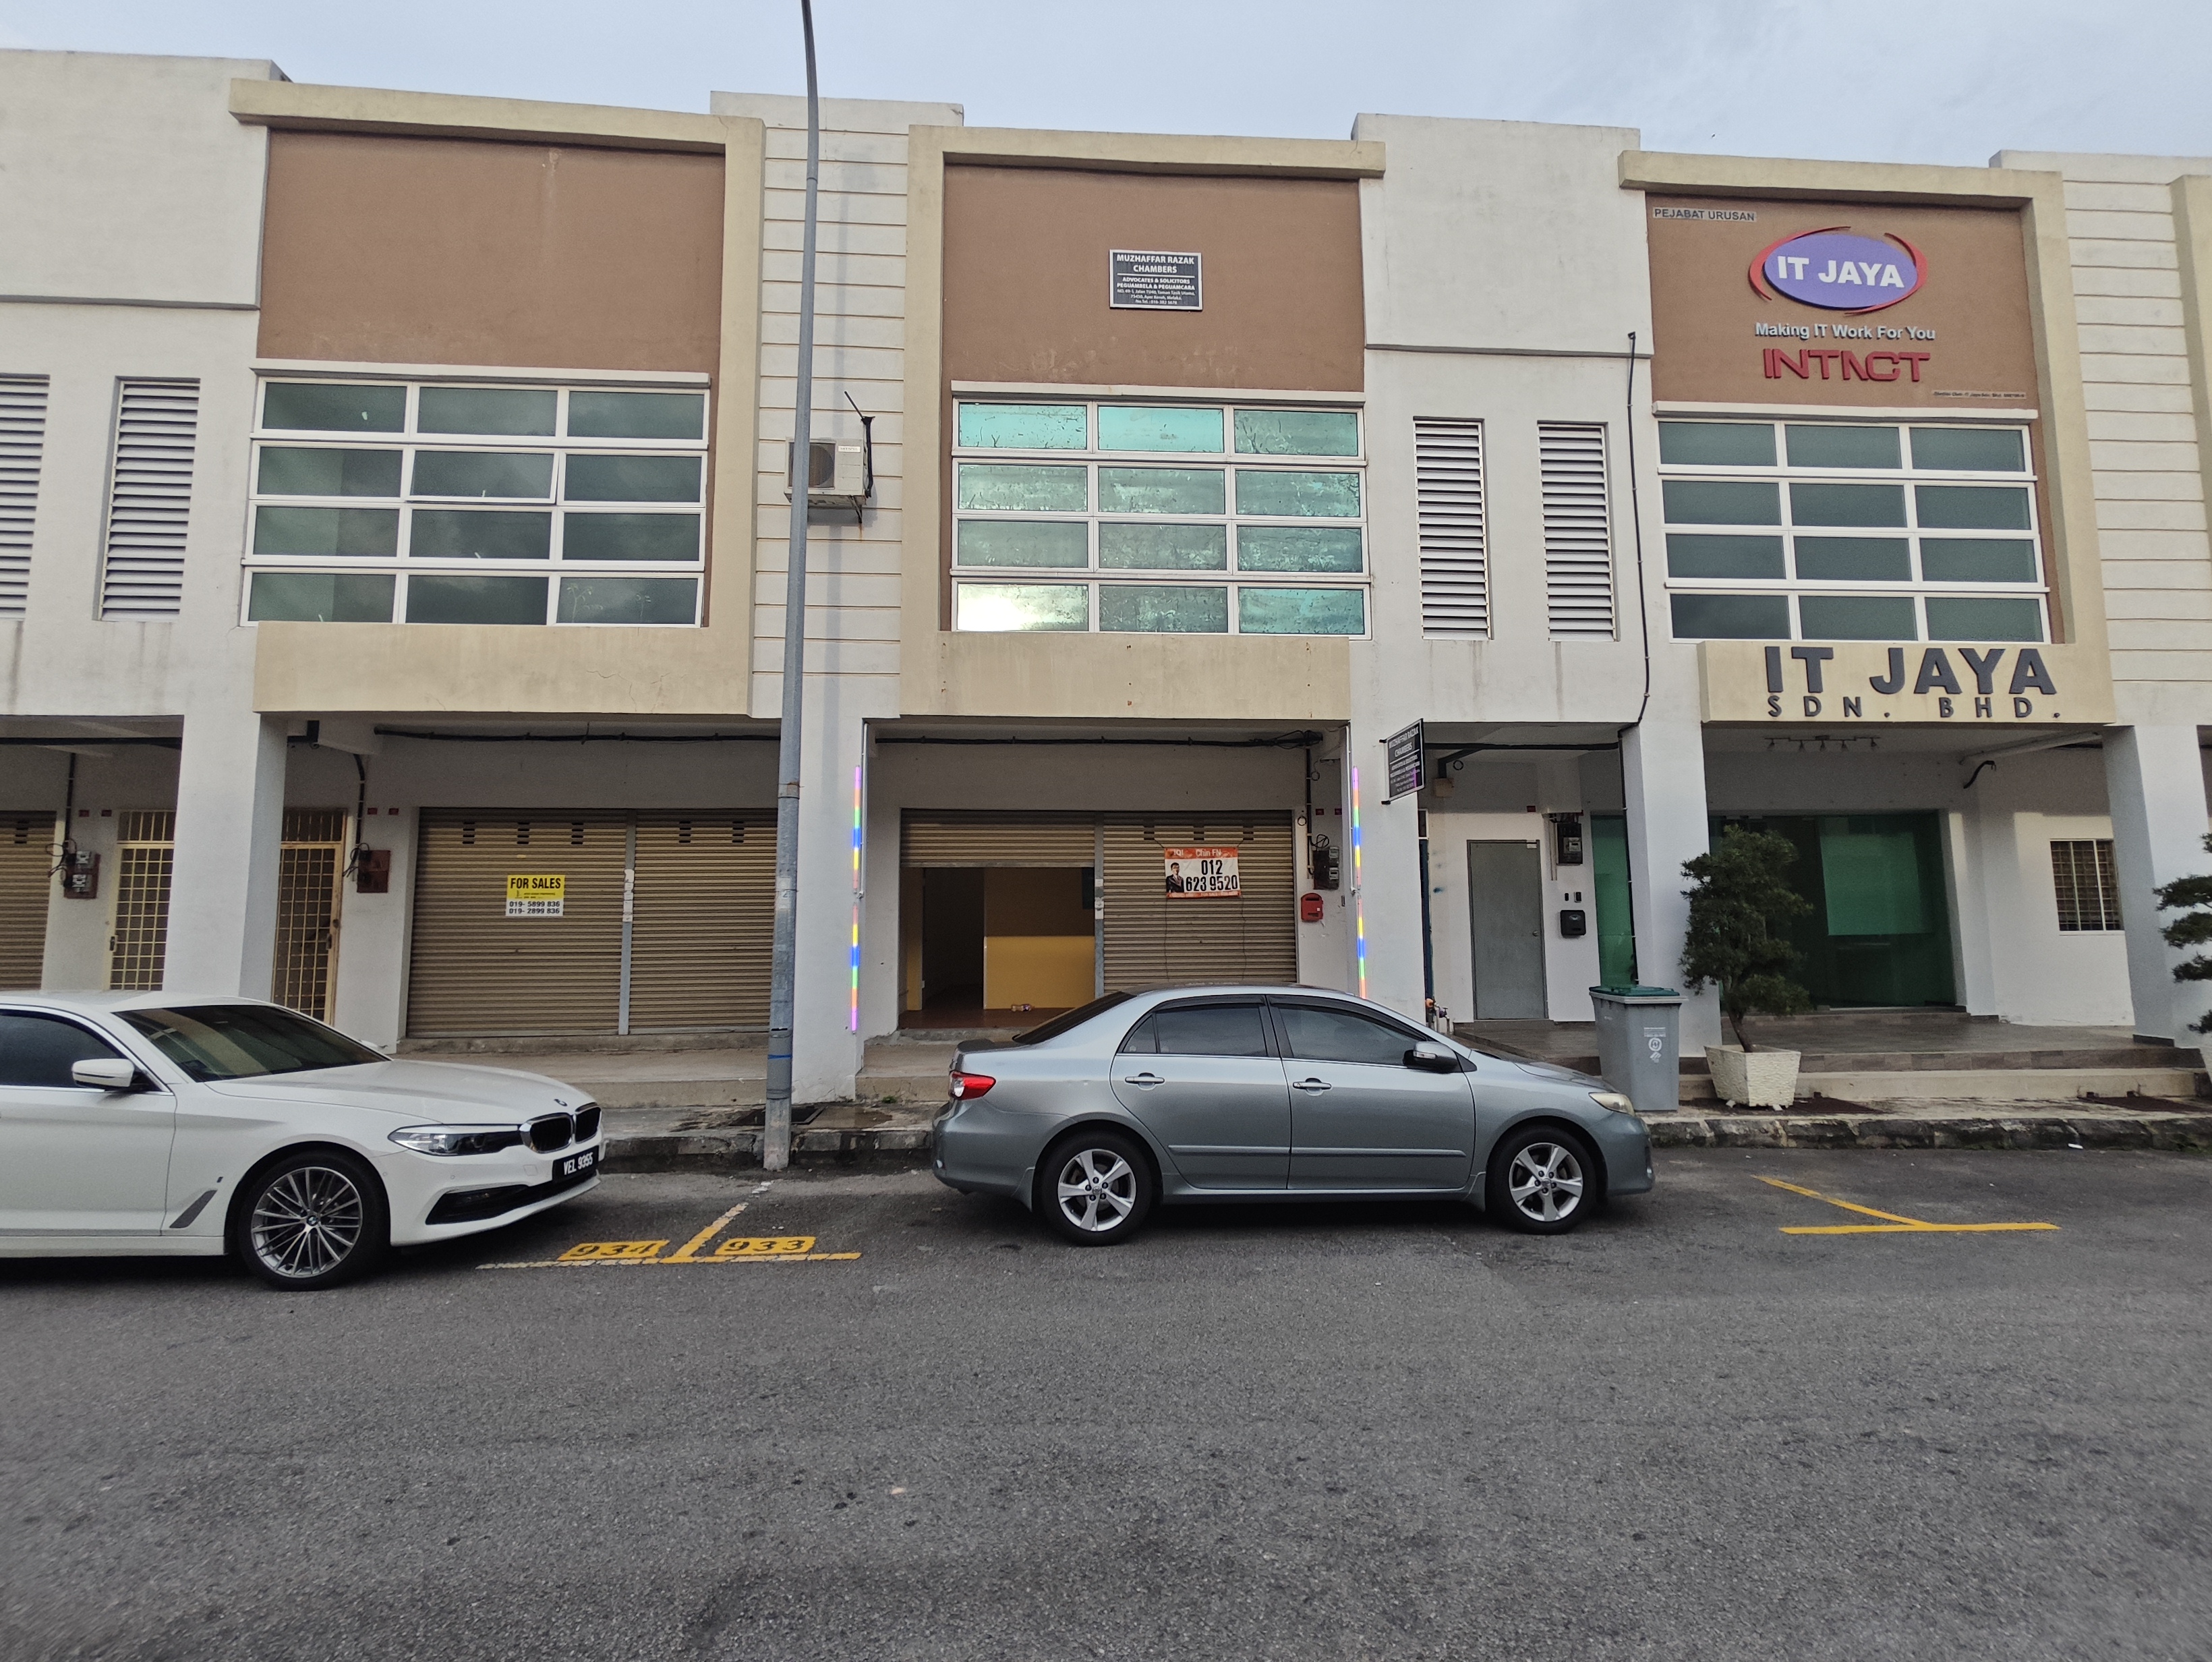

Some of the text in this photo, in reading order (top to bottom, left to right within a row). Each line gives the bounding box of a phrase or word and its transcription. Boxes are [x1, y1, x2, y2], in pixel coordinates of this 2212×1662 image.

[1654, 208, 1755, 221] PEJABAT URUSAN
[1117, 254, 1194, 264] MUZHAFFAR RAZAK
[1133, 264, 1177, 273] CHAMBERS
[1776, 255, 1904, 288] IT JAYA
[1755, 322, 1936, 340] Making IT Work For You
[1764, 646, 2058, 695] IT JAYA
[1768, 695, 2061, 719] SDN. BHD.
[1195, 849, 1211, 857] Chin
[1201, 859, 1223, 875] 012
[510, 878, 561, 889] FOR SALES
[1186, 875, 1238, 891] 623 9520
[563, 1159, 577, 1175] VEL
[570, 1243, 658, 1257] 934
[724, 1240, 805, 1251] 933
